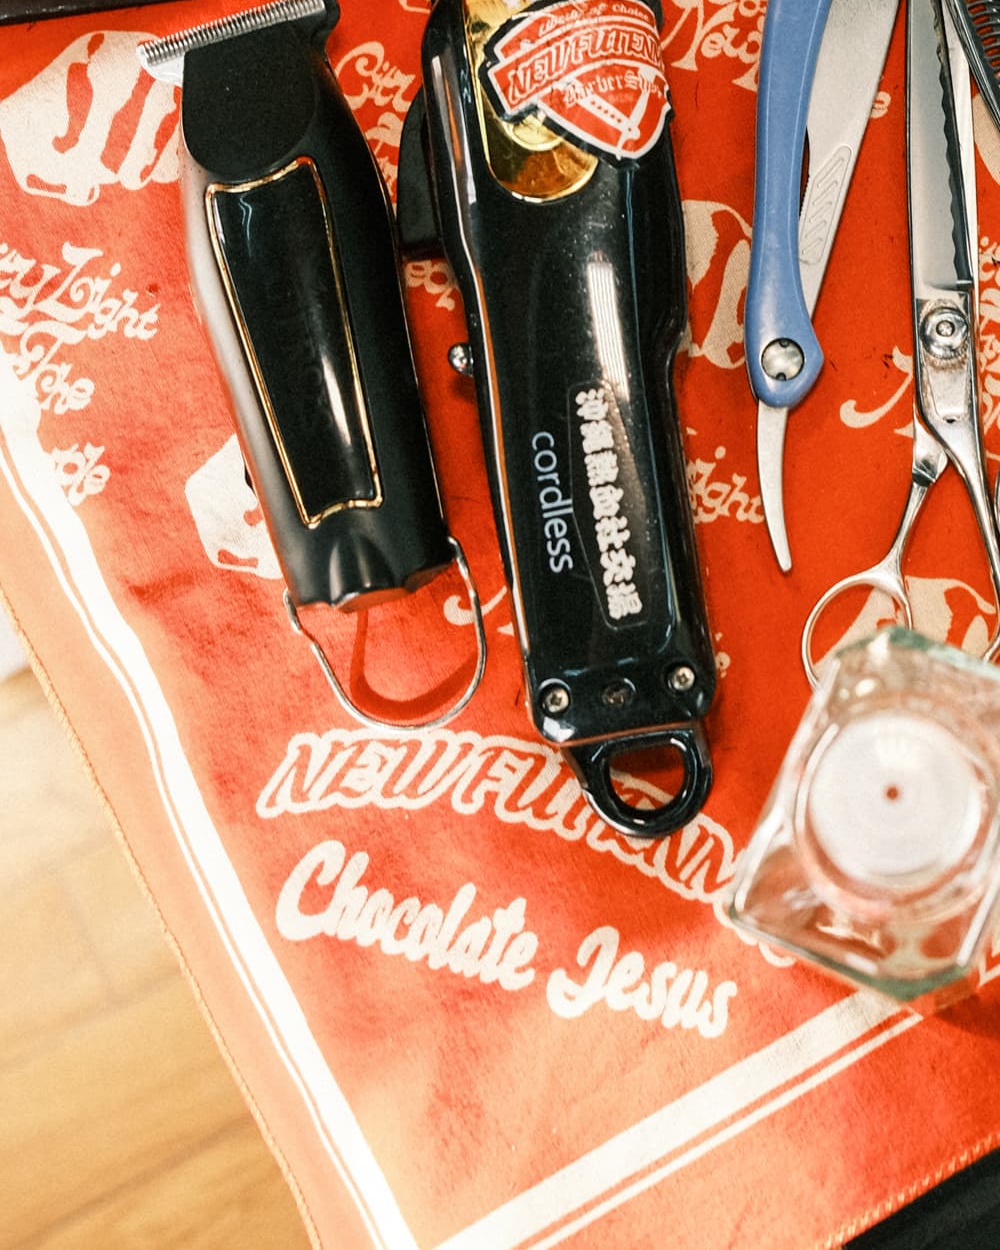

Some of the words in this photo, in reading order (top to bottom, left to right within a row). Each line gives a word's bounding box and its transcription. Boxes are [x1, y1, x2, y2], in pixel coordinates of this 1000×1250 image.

[531, 431, 575, 575] cordless
[276, 840, 540, 991] Chocolate
[546, 925, 738, 1039] Jesus
